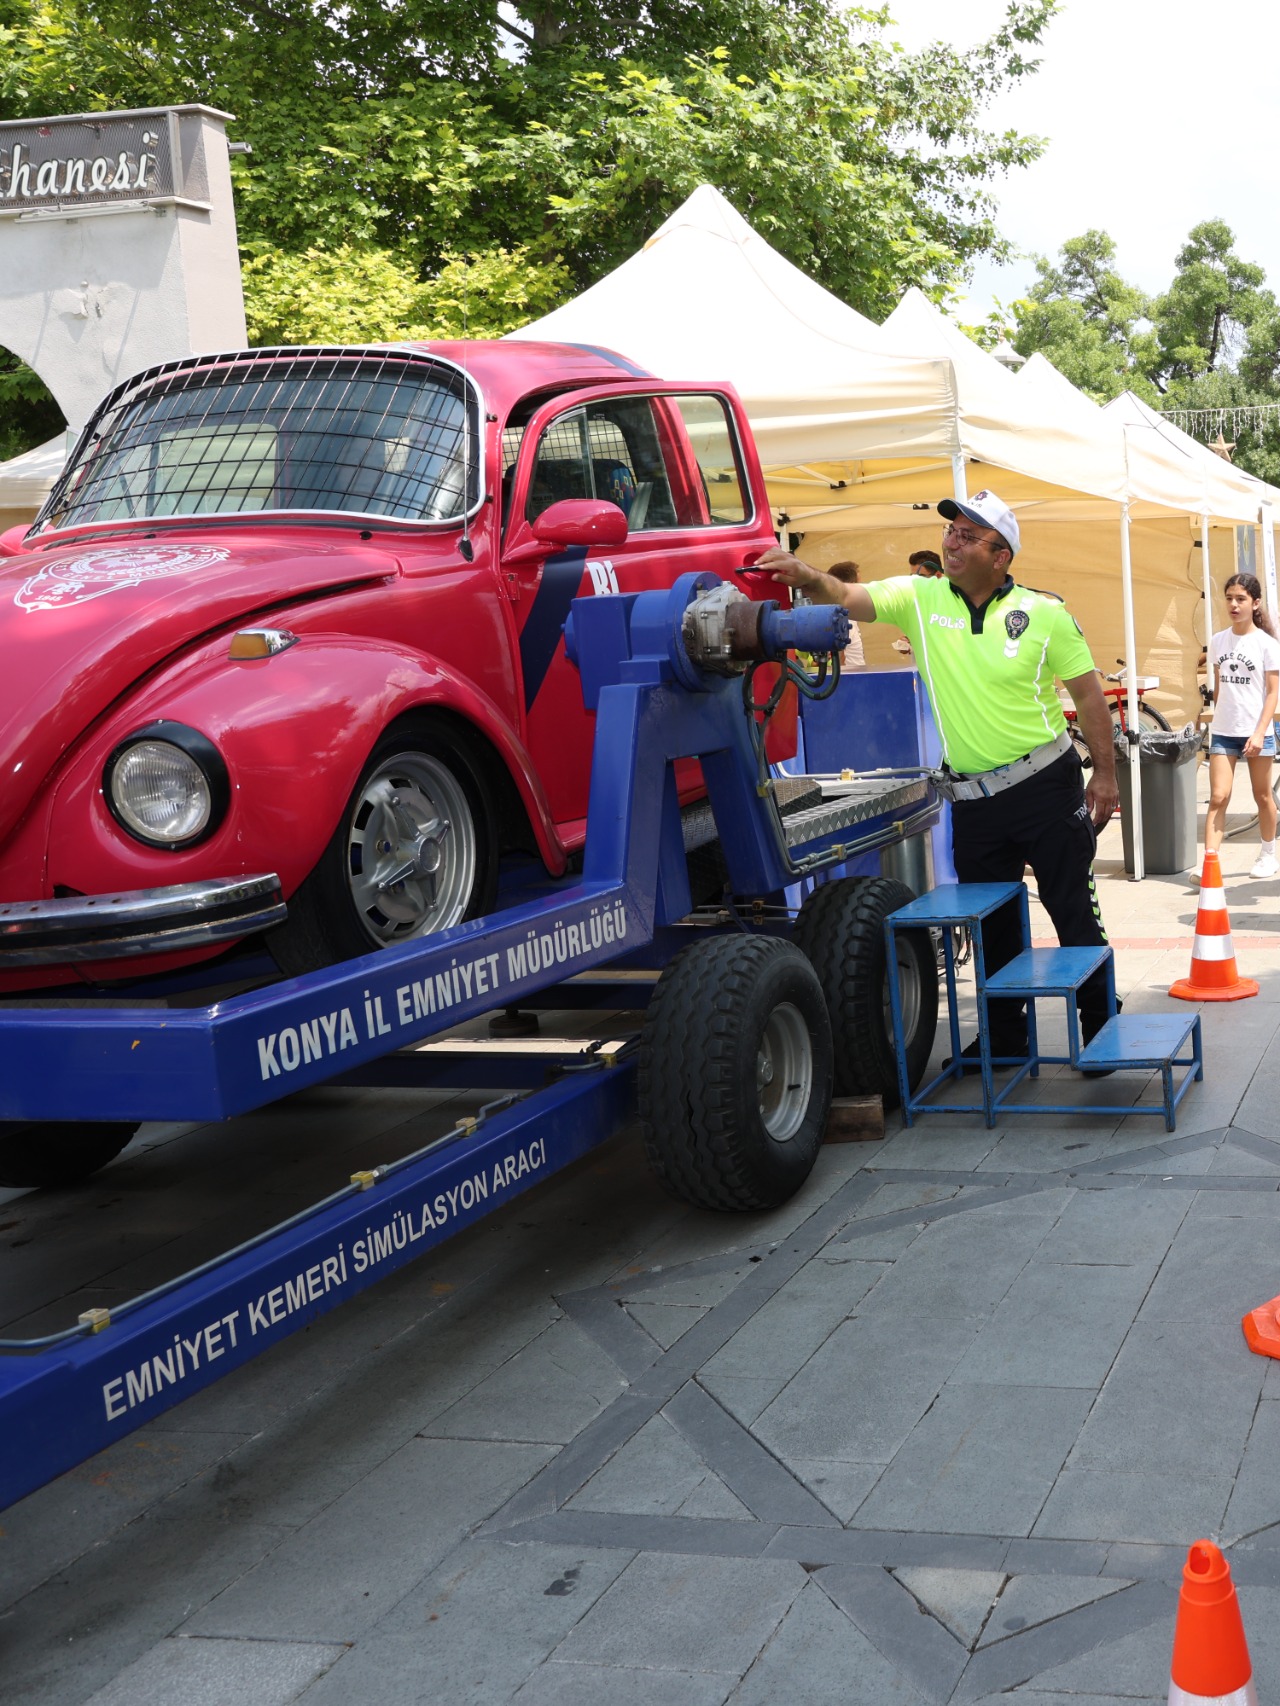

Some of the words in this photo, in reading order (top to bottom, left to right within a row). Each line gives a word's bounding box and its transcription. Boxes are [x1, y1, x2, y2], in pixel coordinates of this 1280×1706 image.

[0, 131, 150, 197] hanesi
[929, 613, 965, 630] POLİS
[1236, 653, 1256, 672] CLUB
[1220, 675, 1251, 685] OLLEGE
[1073, 799, 1088, 820] TRA
[257, 1007, 359, 1081] KONYA
[364, 990, 391, 1039] İL
[396, 953, 500, 1026] EMNİYET
[507, 900, 627, 982] MÜDÜRLÜĞÜ
[102, 1309, 241, 1421] EMNİYET
[248, 1243, 348, 1336] KEMERİ
[353, 1171, 489, 1273] SİMÜLASYON
[492, 1137, 547, 1194] ARACI
